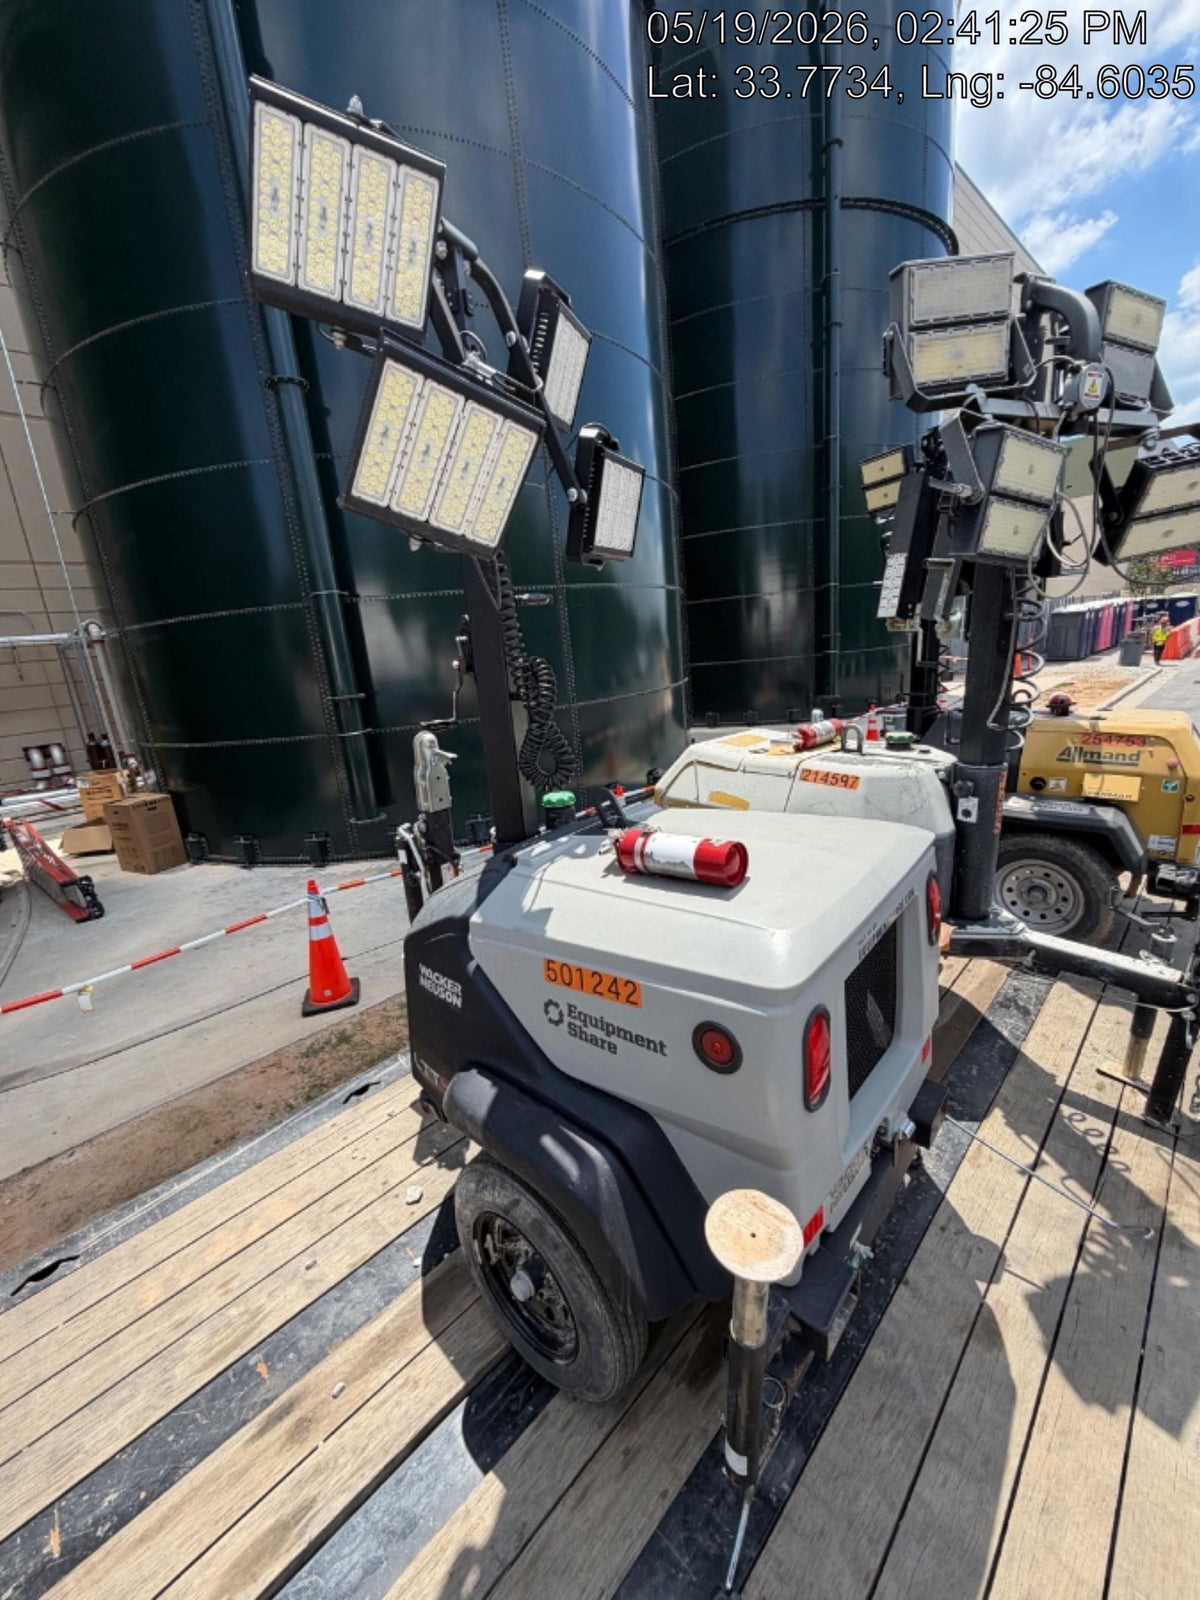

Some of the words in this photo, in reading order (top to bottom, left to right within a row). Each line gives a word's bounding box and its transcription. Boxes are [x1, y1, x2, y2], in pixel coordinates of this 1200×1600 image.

[801, 768, 861, 790] 214597
[419, 962, 462, 997] WACKER
[419, 975, 462, 1009] NEUSON
[545, 959, 639, 1005] 501242
[566, 1001, 668, 1058] Equipment
[567, 1020, 618, 1055] Share
